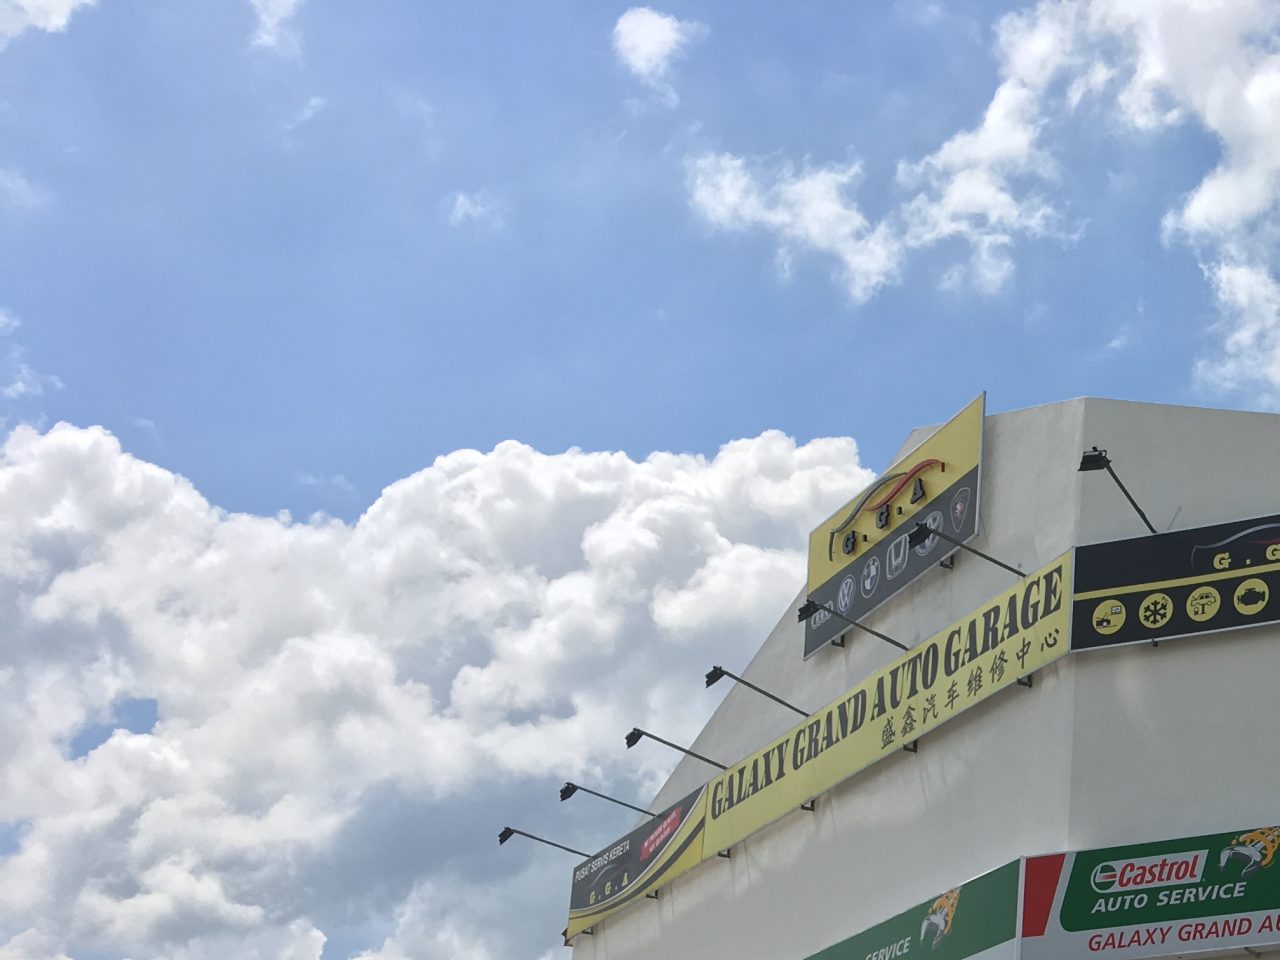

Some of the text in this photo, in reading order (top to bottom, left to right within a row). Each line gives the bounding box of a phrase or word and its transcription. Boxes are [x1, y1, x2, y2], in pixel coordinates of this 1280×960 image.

[711, 565, 1062, 820] GALAXY GRAND AUTO GARAGE
[881, 628, 1060, 750] 盛鑫汽车维修中心
[575, 840, 630, 882] PUSAT SERVIS KERETA
[1118, 855, 1200, 888] Castrol
[1091, 882, 1247, 914] AUTO SERVICE
[1088, 925, 1173, 952] GALAXY
[1177, 917, 1253, 942] GRAND
